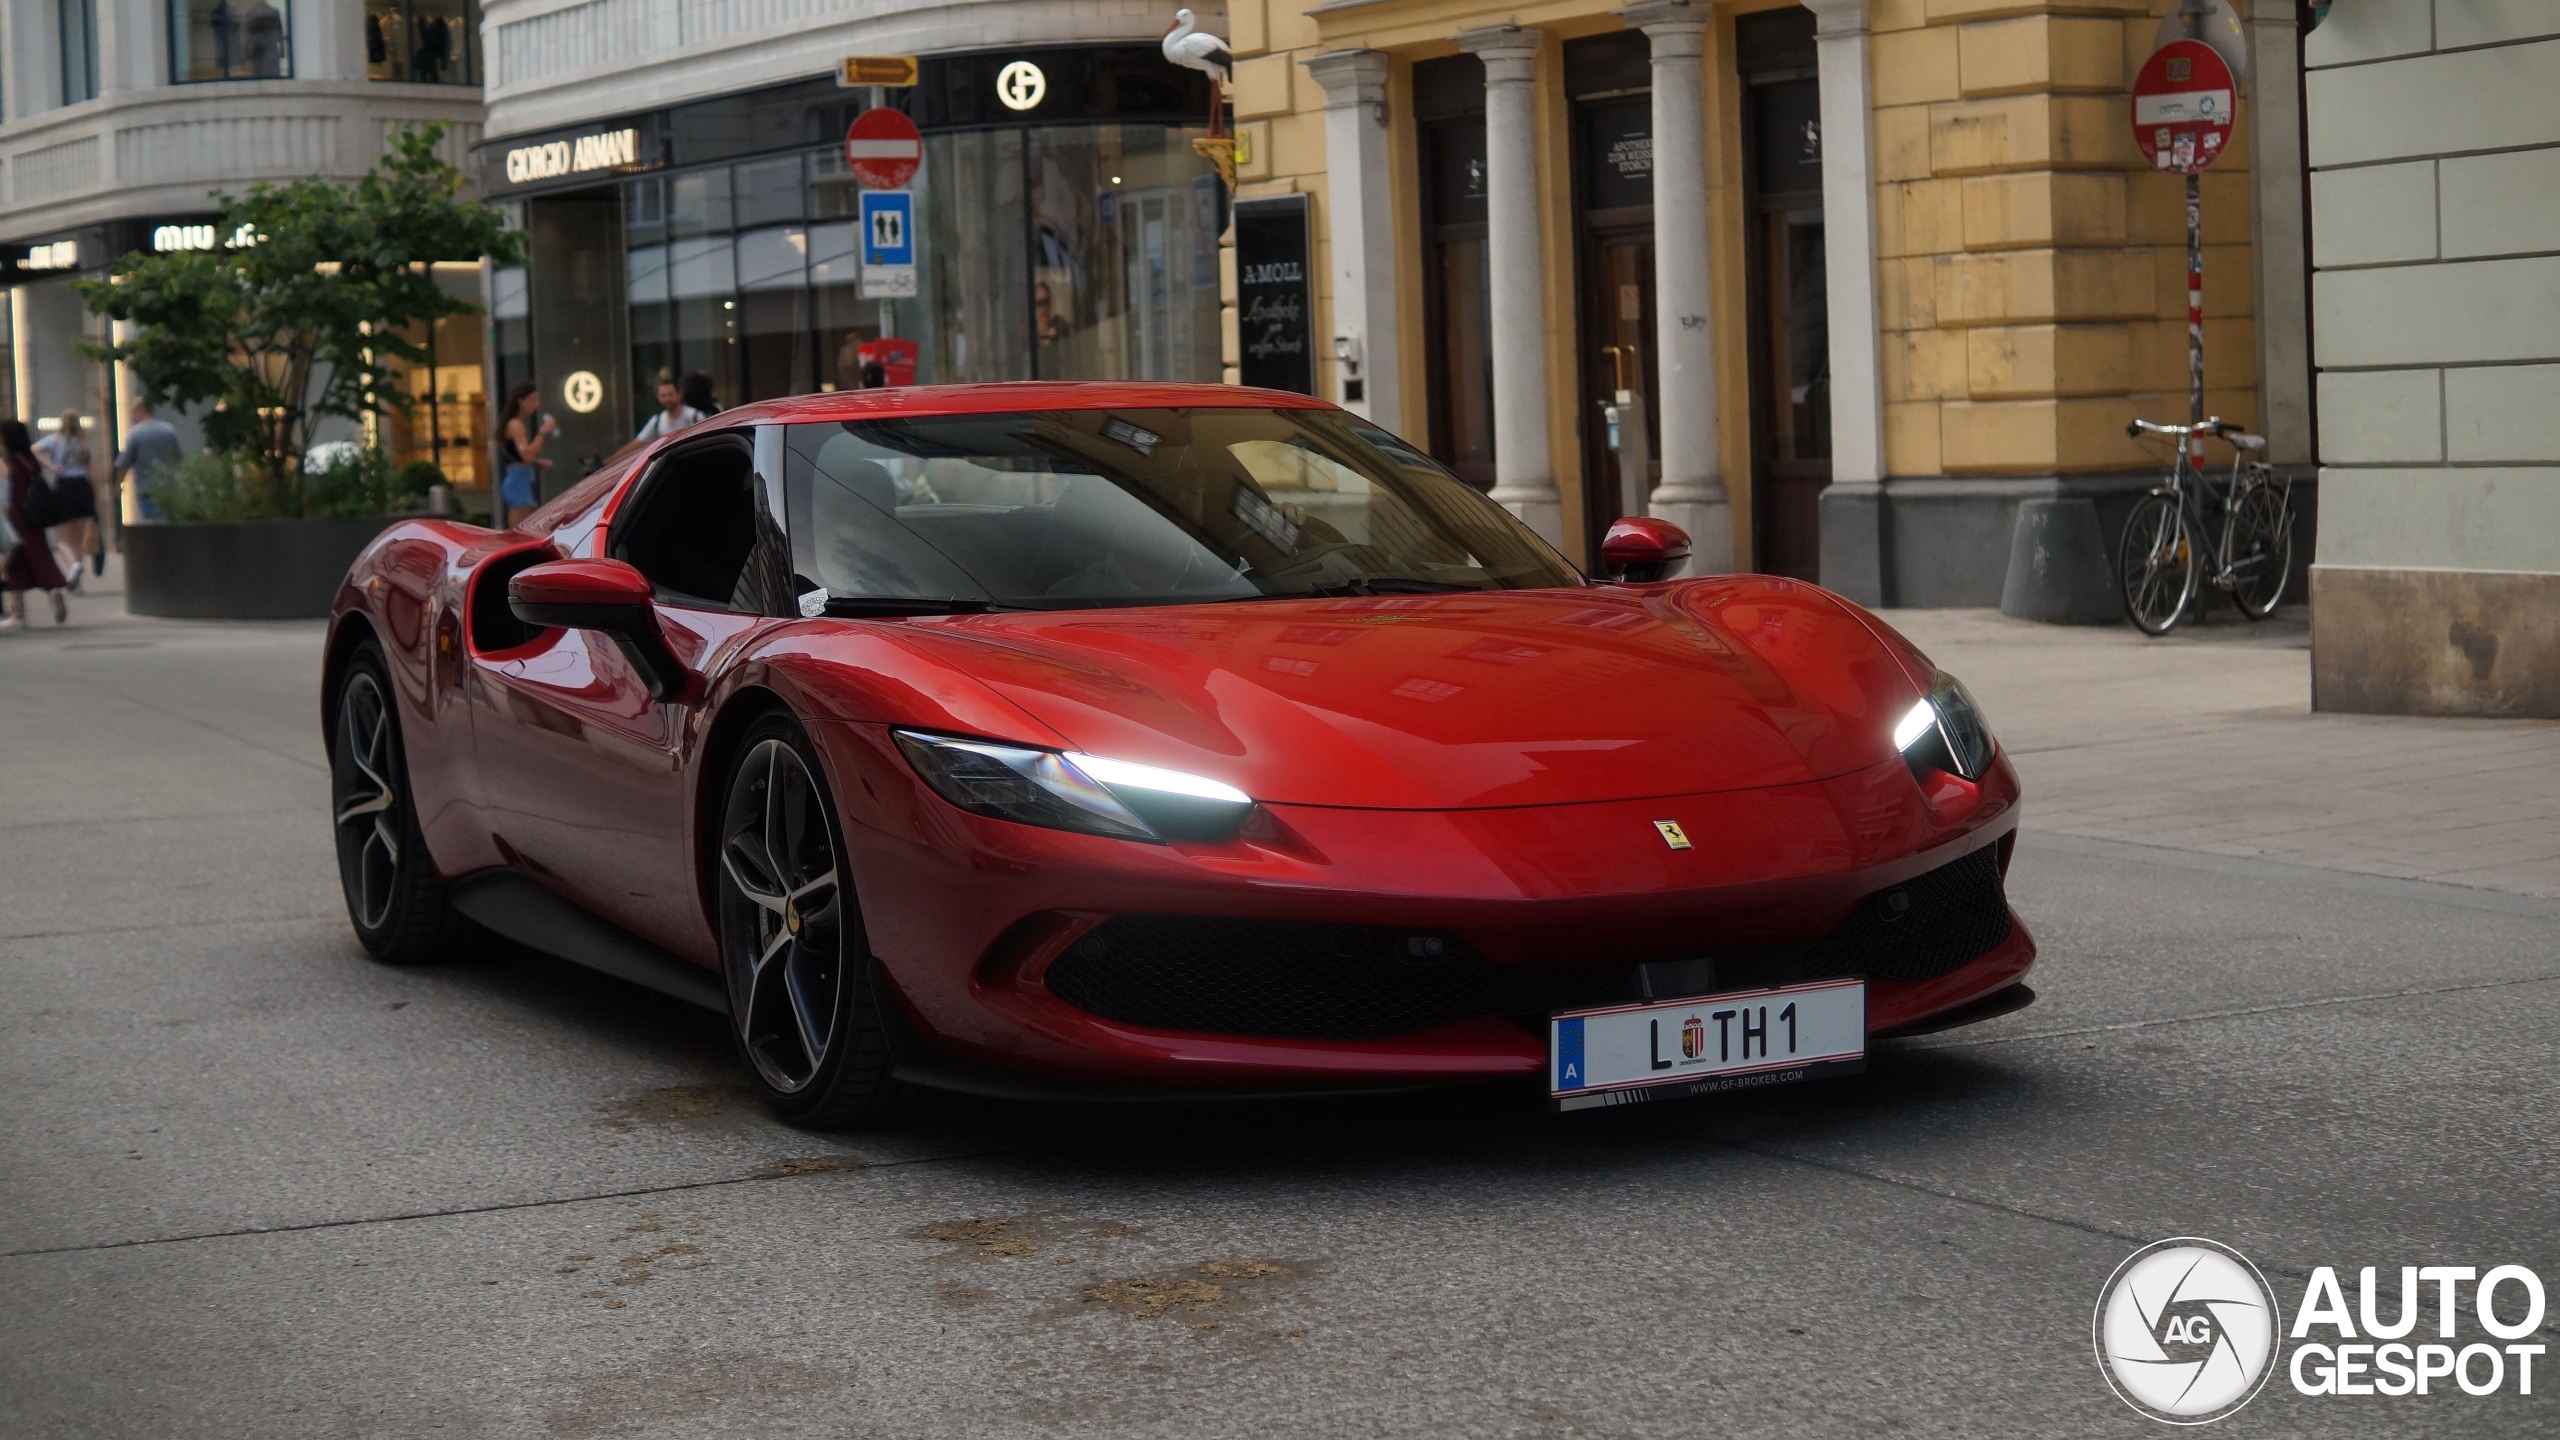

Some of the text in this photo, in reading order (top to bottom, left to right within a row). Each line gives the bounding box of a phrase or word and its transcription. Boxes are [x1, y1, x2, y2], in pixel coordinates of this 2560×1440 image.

[506, 128, 636, 184] GIORGIO ARMANI
[1650, 1018, 1673, 1071] L
[1564, 1062, 1578, 1080] A
[1689, 1070, 1804, 1094] WWW.GF-BROKER.COM
